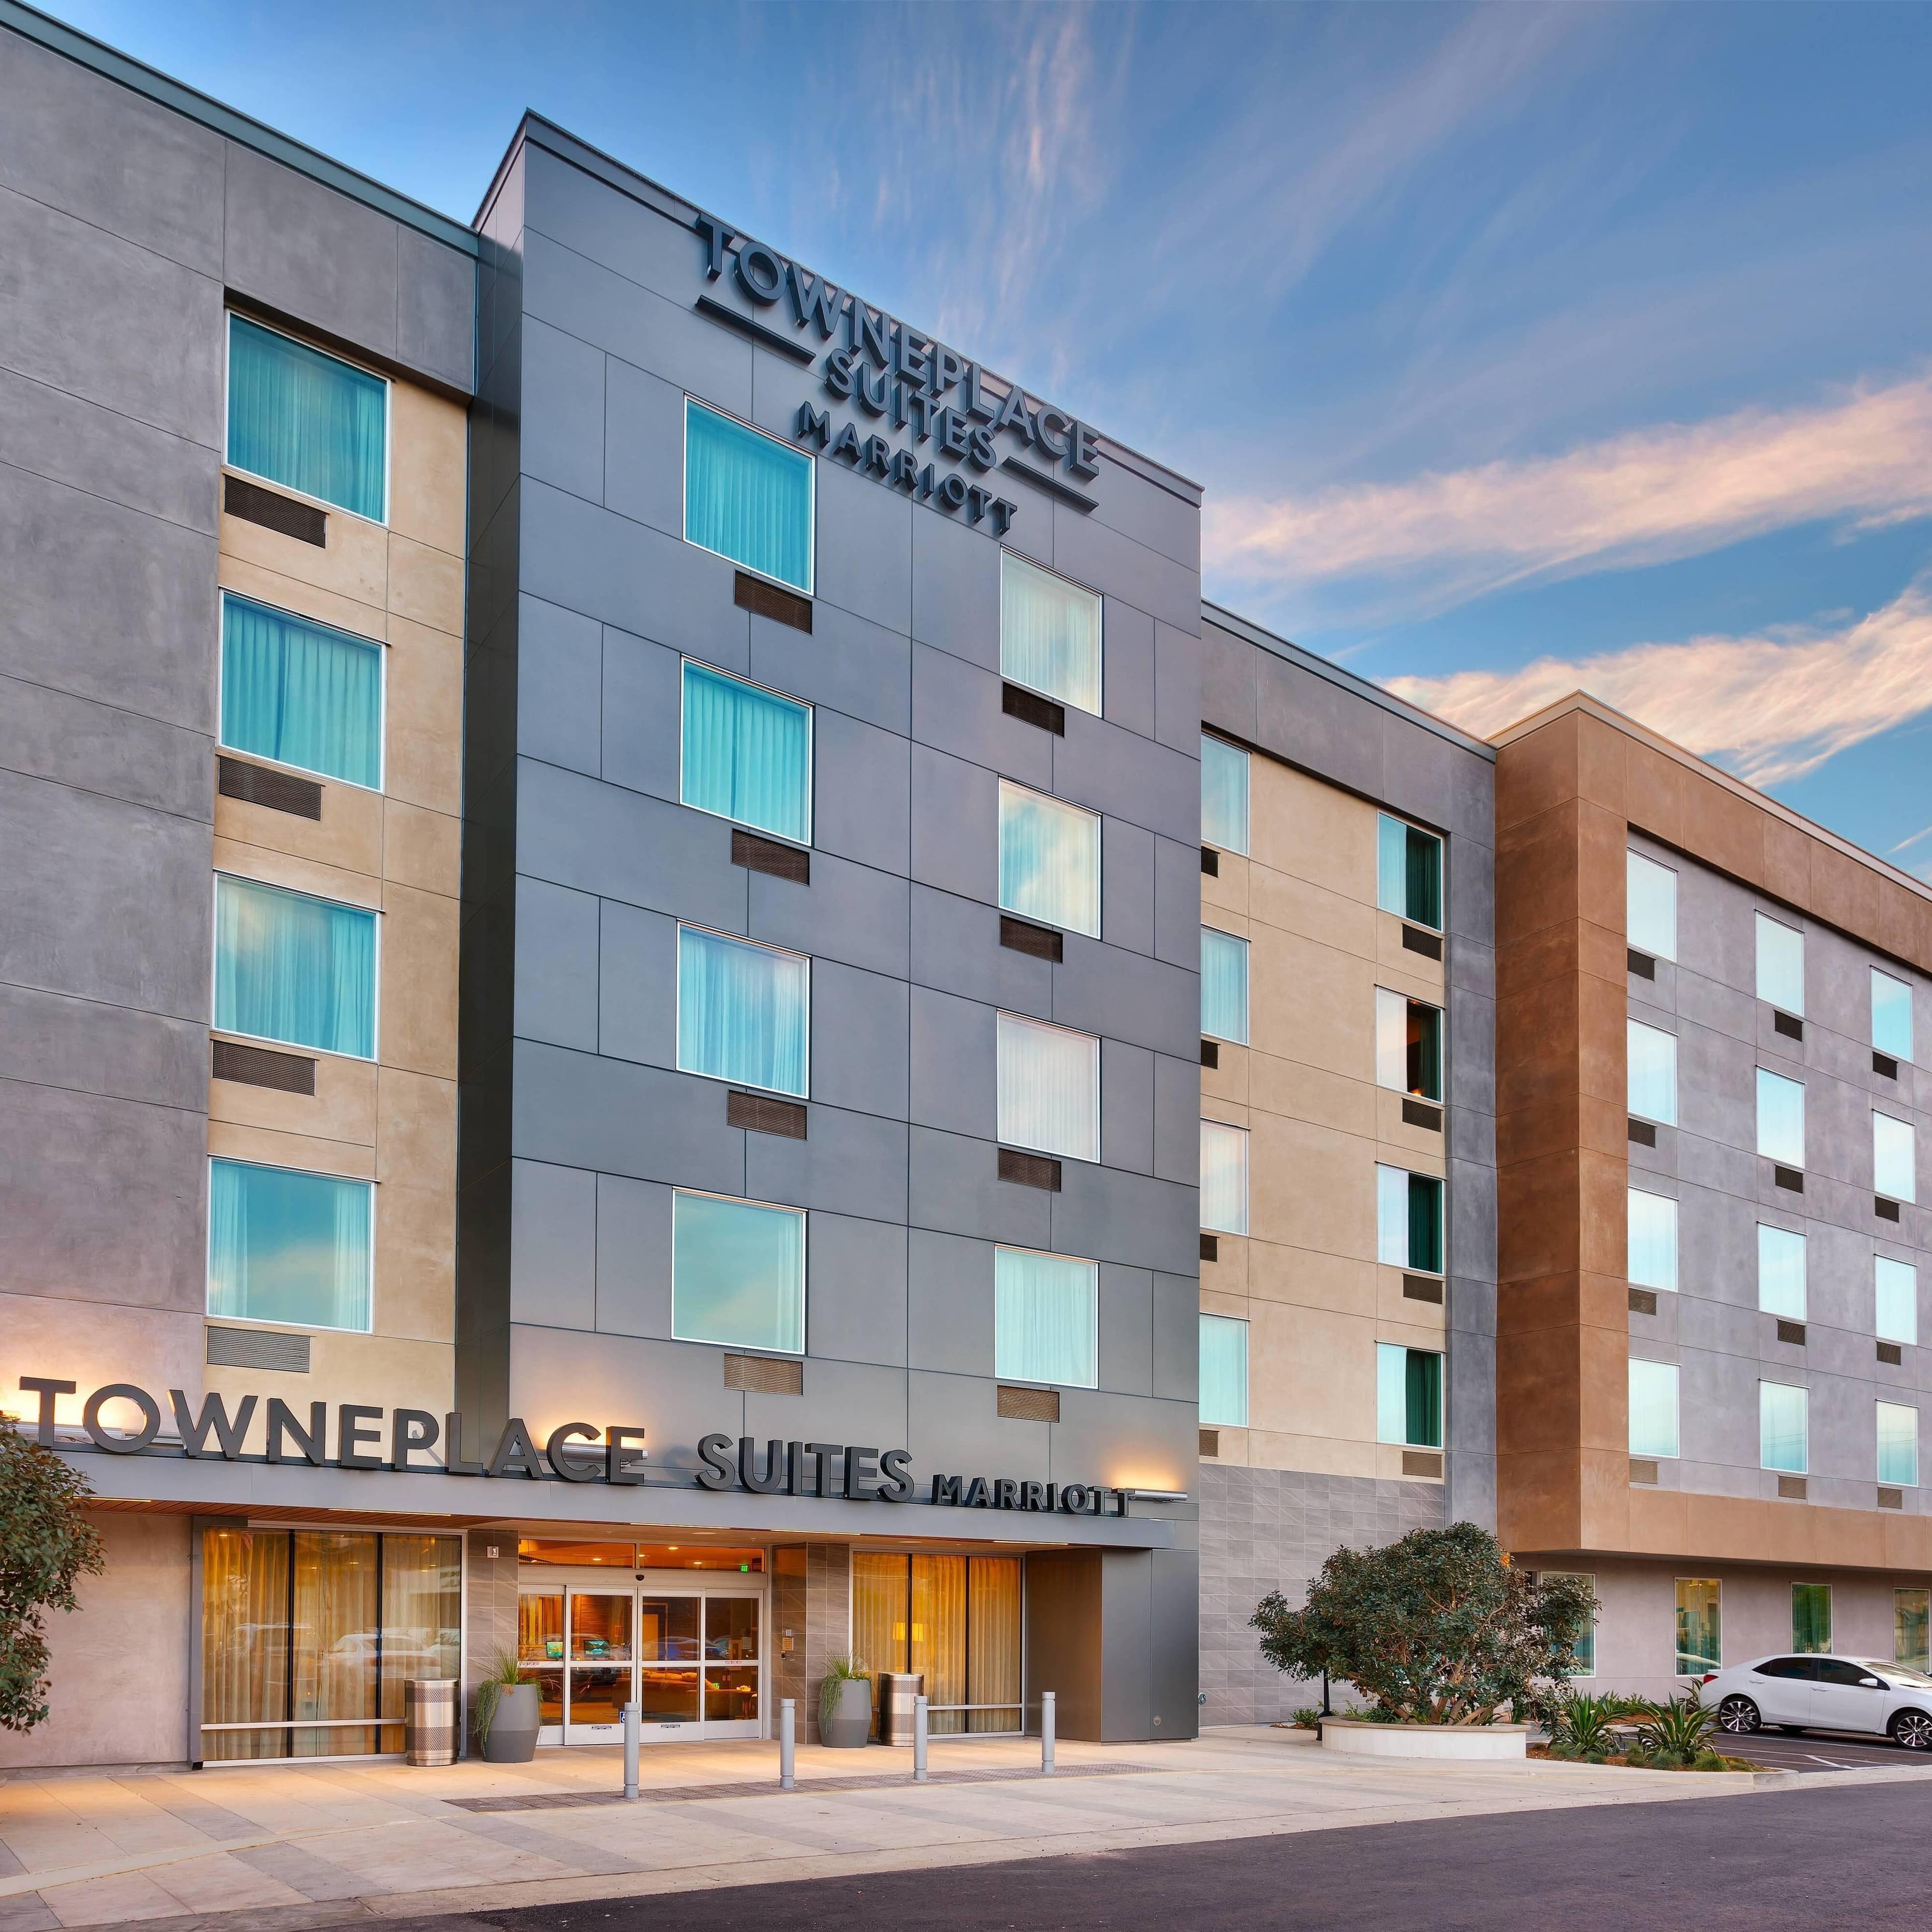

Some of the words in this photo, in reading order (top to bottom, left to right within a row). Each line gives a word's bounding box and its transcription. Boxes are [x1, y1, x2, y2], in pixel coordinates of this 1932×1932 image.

[696, 213, 1099, 480] TOWNEPLACE
[824, 348, 997, 472] SUITES
[798, 401, 1017, 535] MARRIOTT
[19, 1376, 645, 1484] TOWNEPLACE
[694, 1433, 914, 1502] SUITES
[931, 1474, 1135, 1517] MARRIOTT
